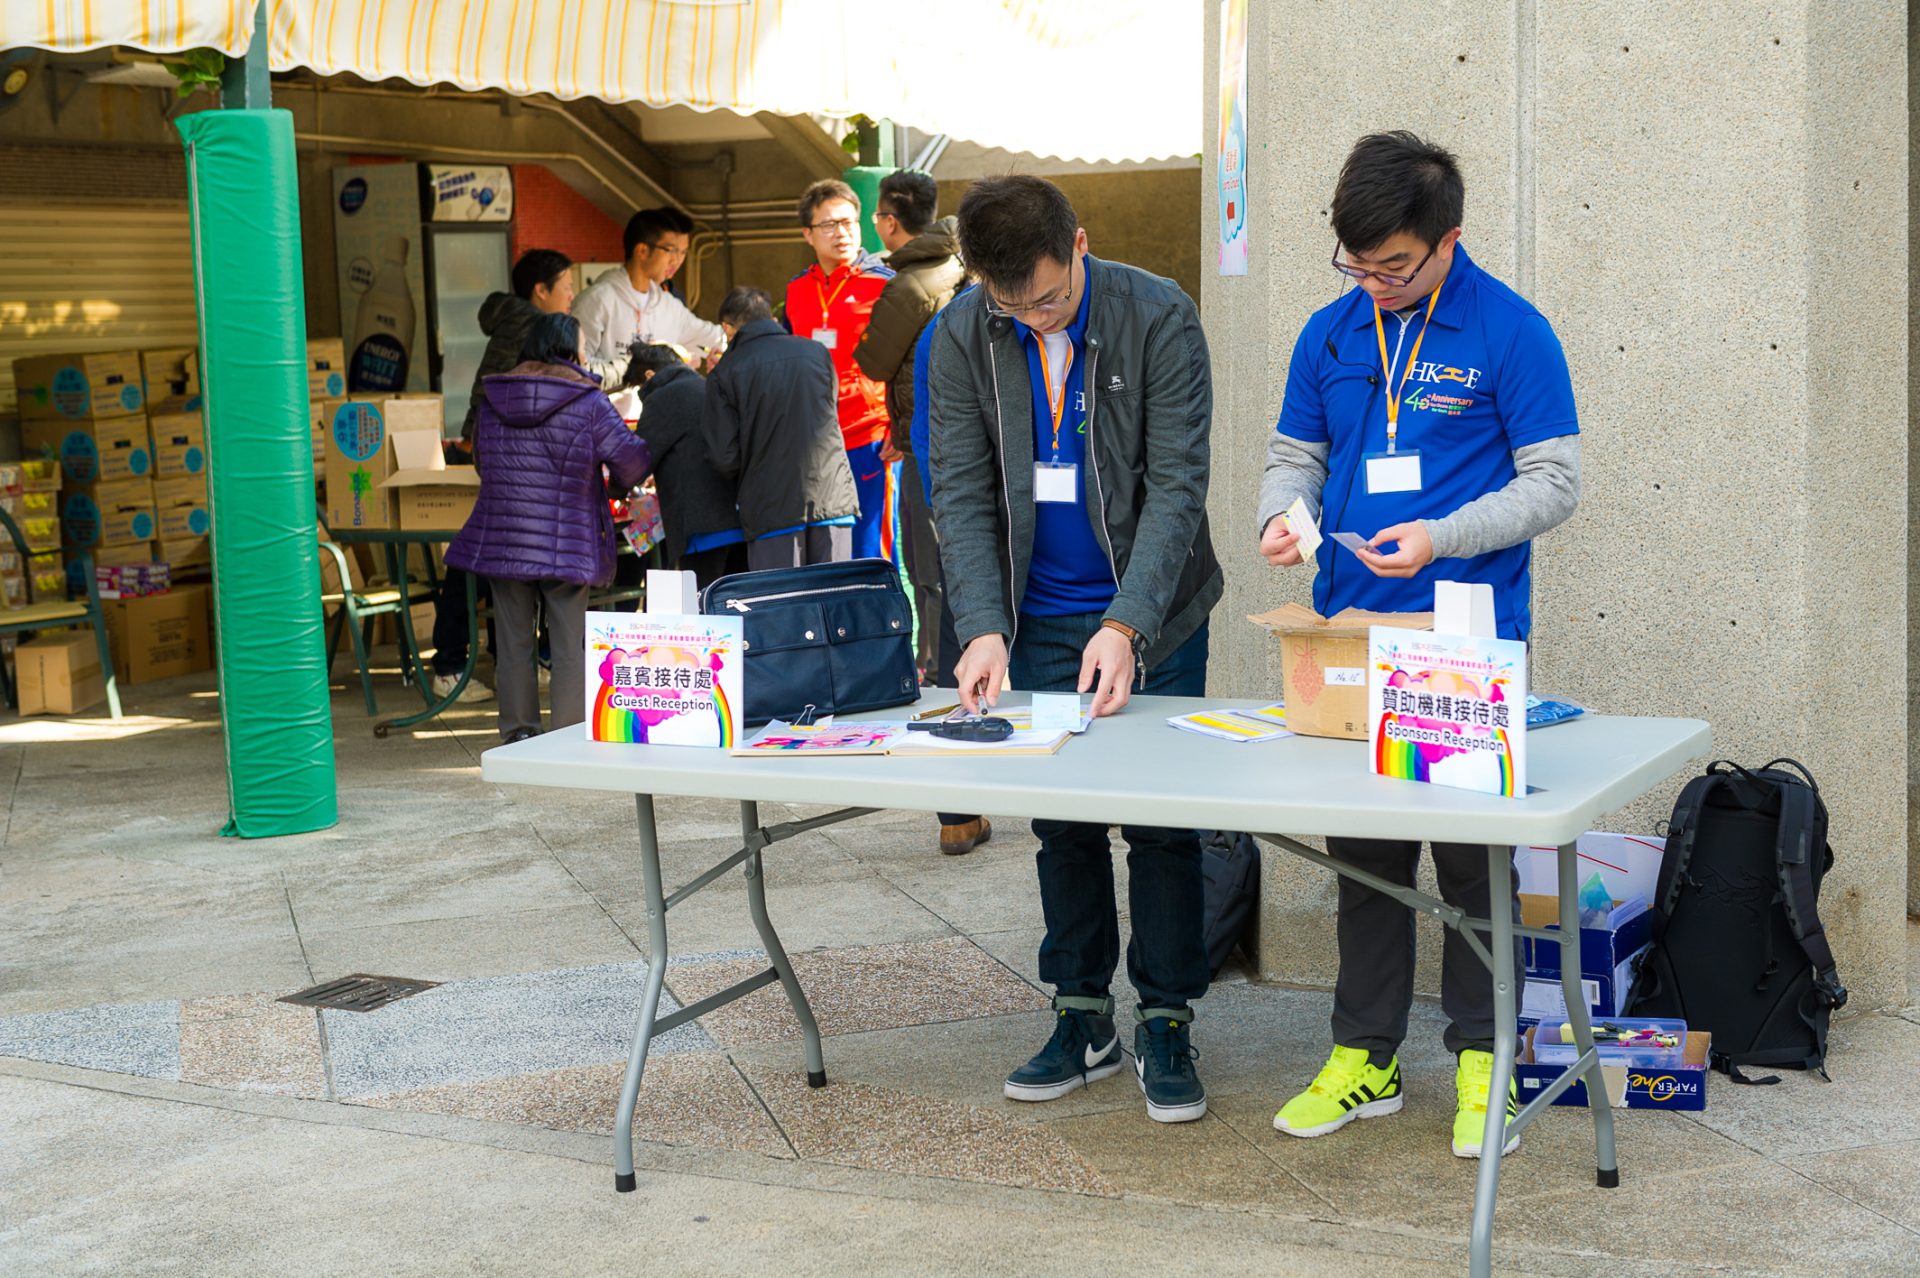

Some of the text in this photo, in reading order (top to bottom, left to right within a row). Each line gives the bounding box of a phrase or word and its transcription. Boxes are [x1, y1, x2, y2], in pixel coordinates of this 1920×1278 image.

[1430, 392, 1474, 407] Anniversary
[614, 665, 713, 690] 嘉賓接待處
[614, 694, 713, 713] Guest Reception
[1382, 687, 1510, 729] 贊助機構接待處
[1386, 722, 1441, 743] Sponsors
[1444, 730, 1505, 753] Reception
